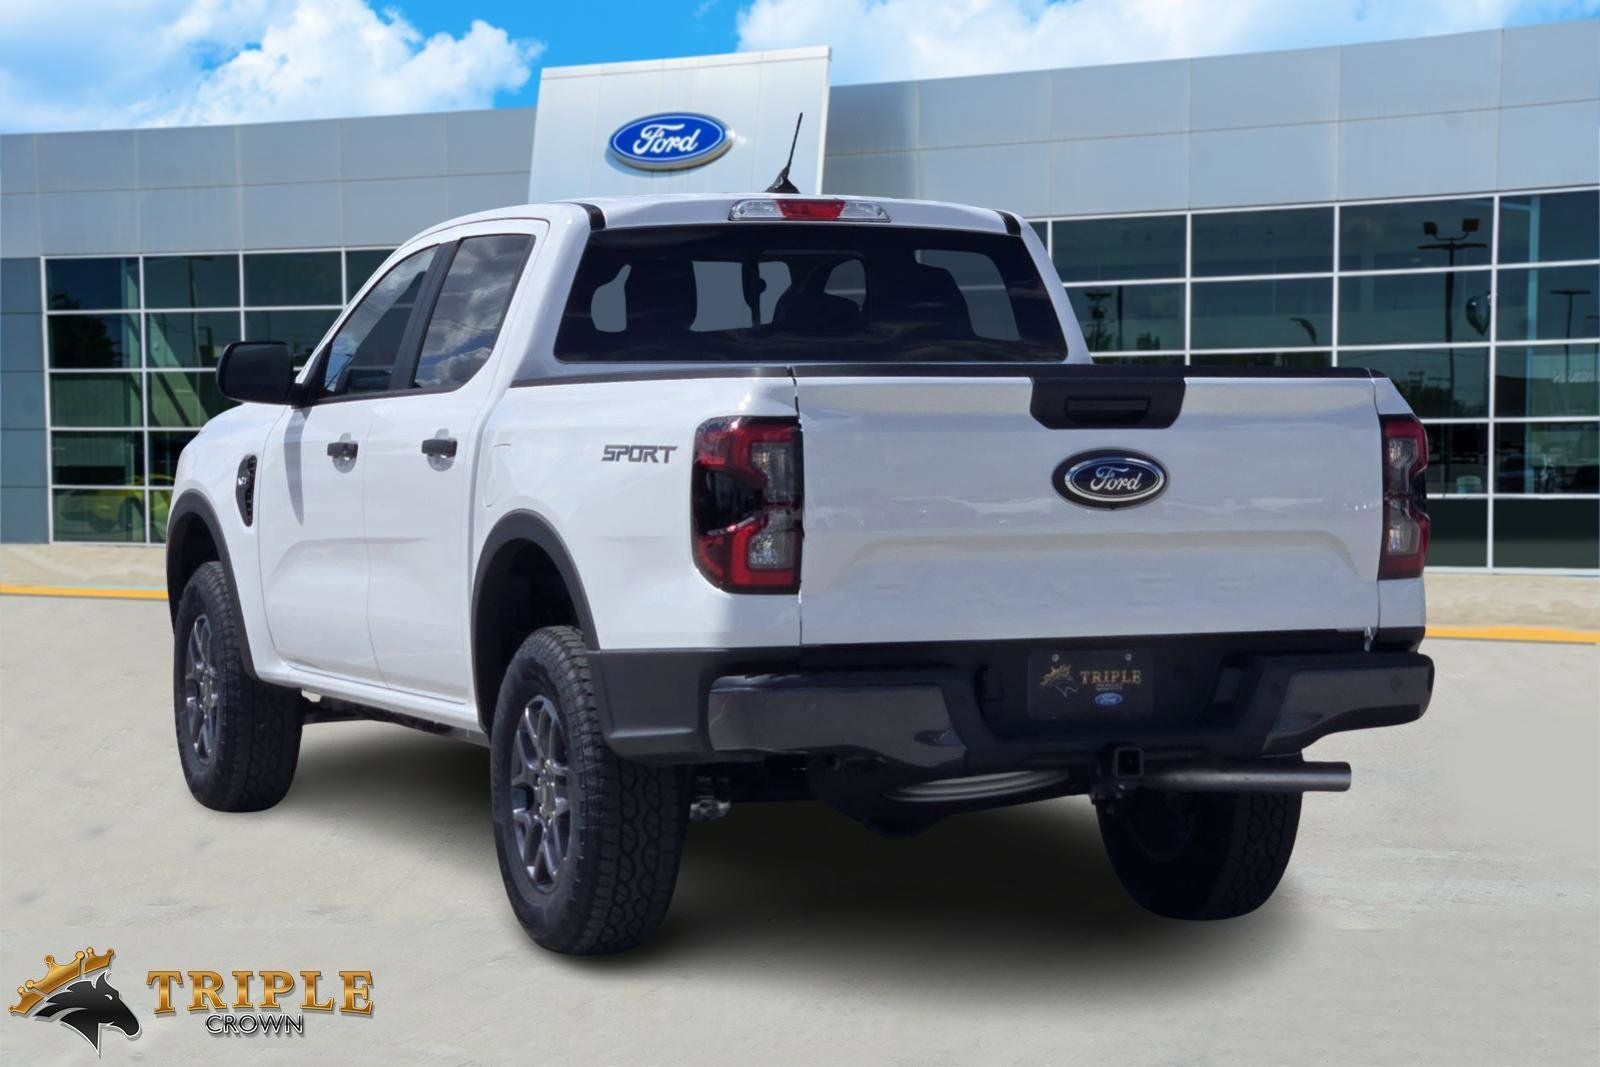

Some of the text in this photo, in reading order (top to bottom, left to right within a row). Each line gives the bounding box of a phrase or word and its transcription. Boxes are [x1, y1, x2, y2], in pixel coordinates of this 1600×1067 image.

[632, 123, 701, 155] Ford
[601, 444, 678, 464] SPORT
[1090, 465, 1142, 490] Ford
[1080, 670, 1142, 685] TRIPLE
